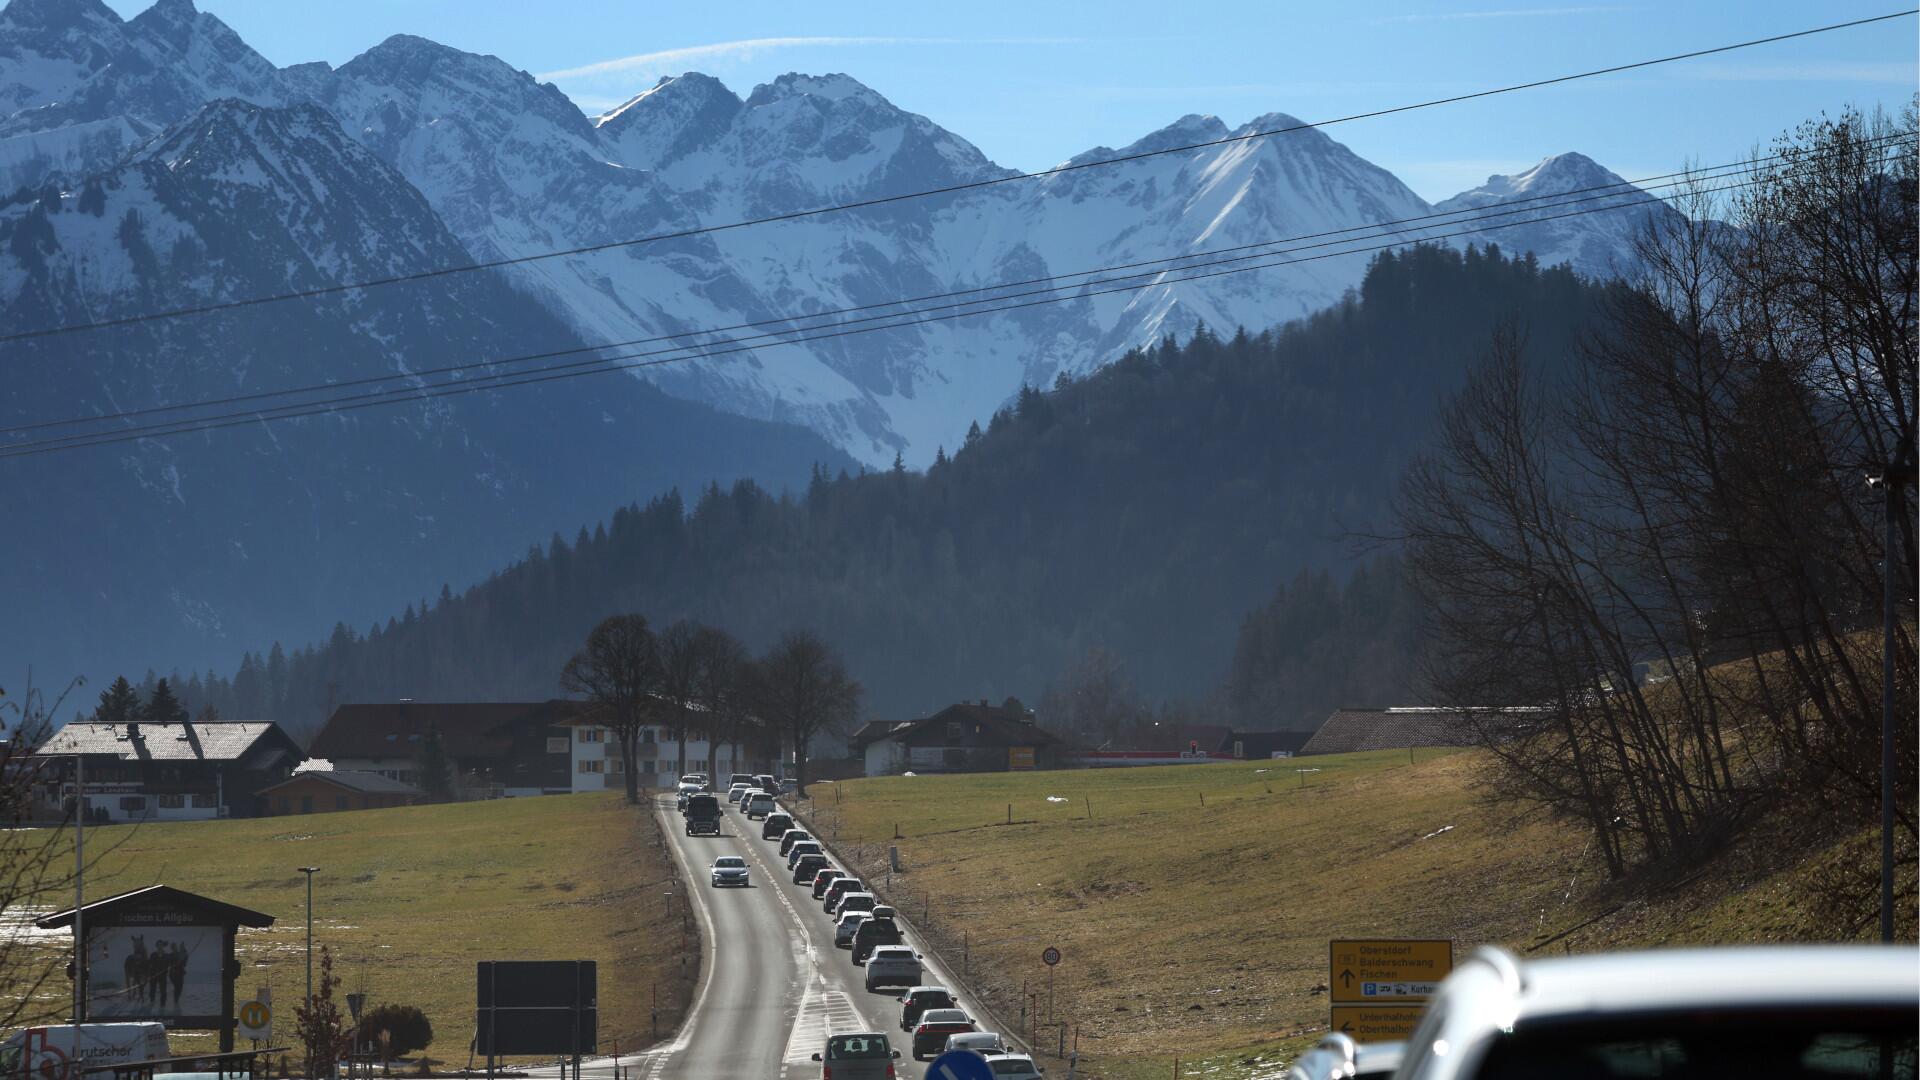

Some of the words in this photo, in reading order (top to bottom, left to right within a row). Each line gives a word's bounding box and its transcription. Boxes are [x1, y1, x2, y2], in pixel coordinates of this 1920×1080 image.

[163, 911, 194, 925] Allgäu
[1360, 946, 1411, 955] Oberstdorf
[1047, 952, 1056, 961] 80
[1360, 958, 1434, 968] Balderschwang
[1360, 969, 1397, 978] Fischen
[1411, 983, 1435, 994] Kurha
